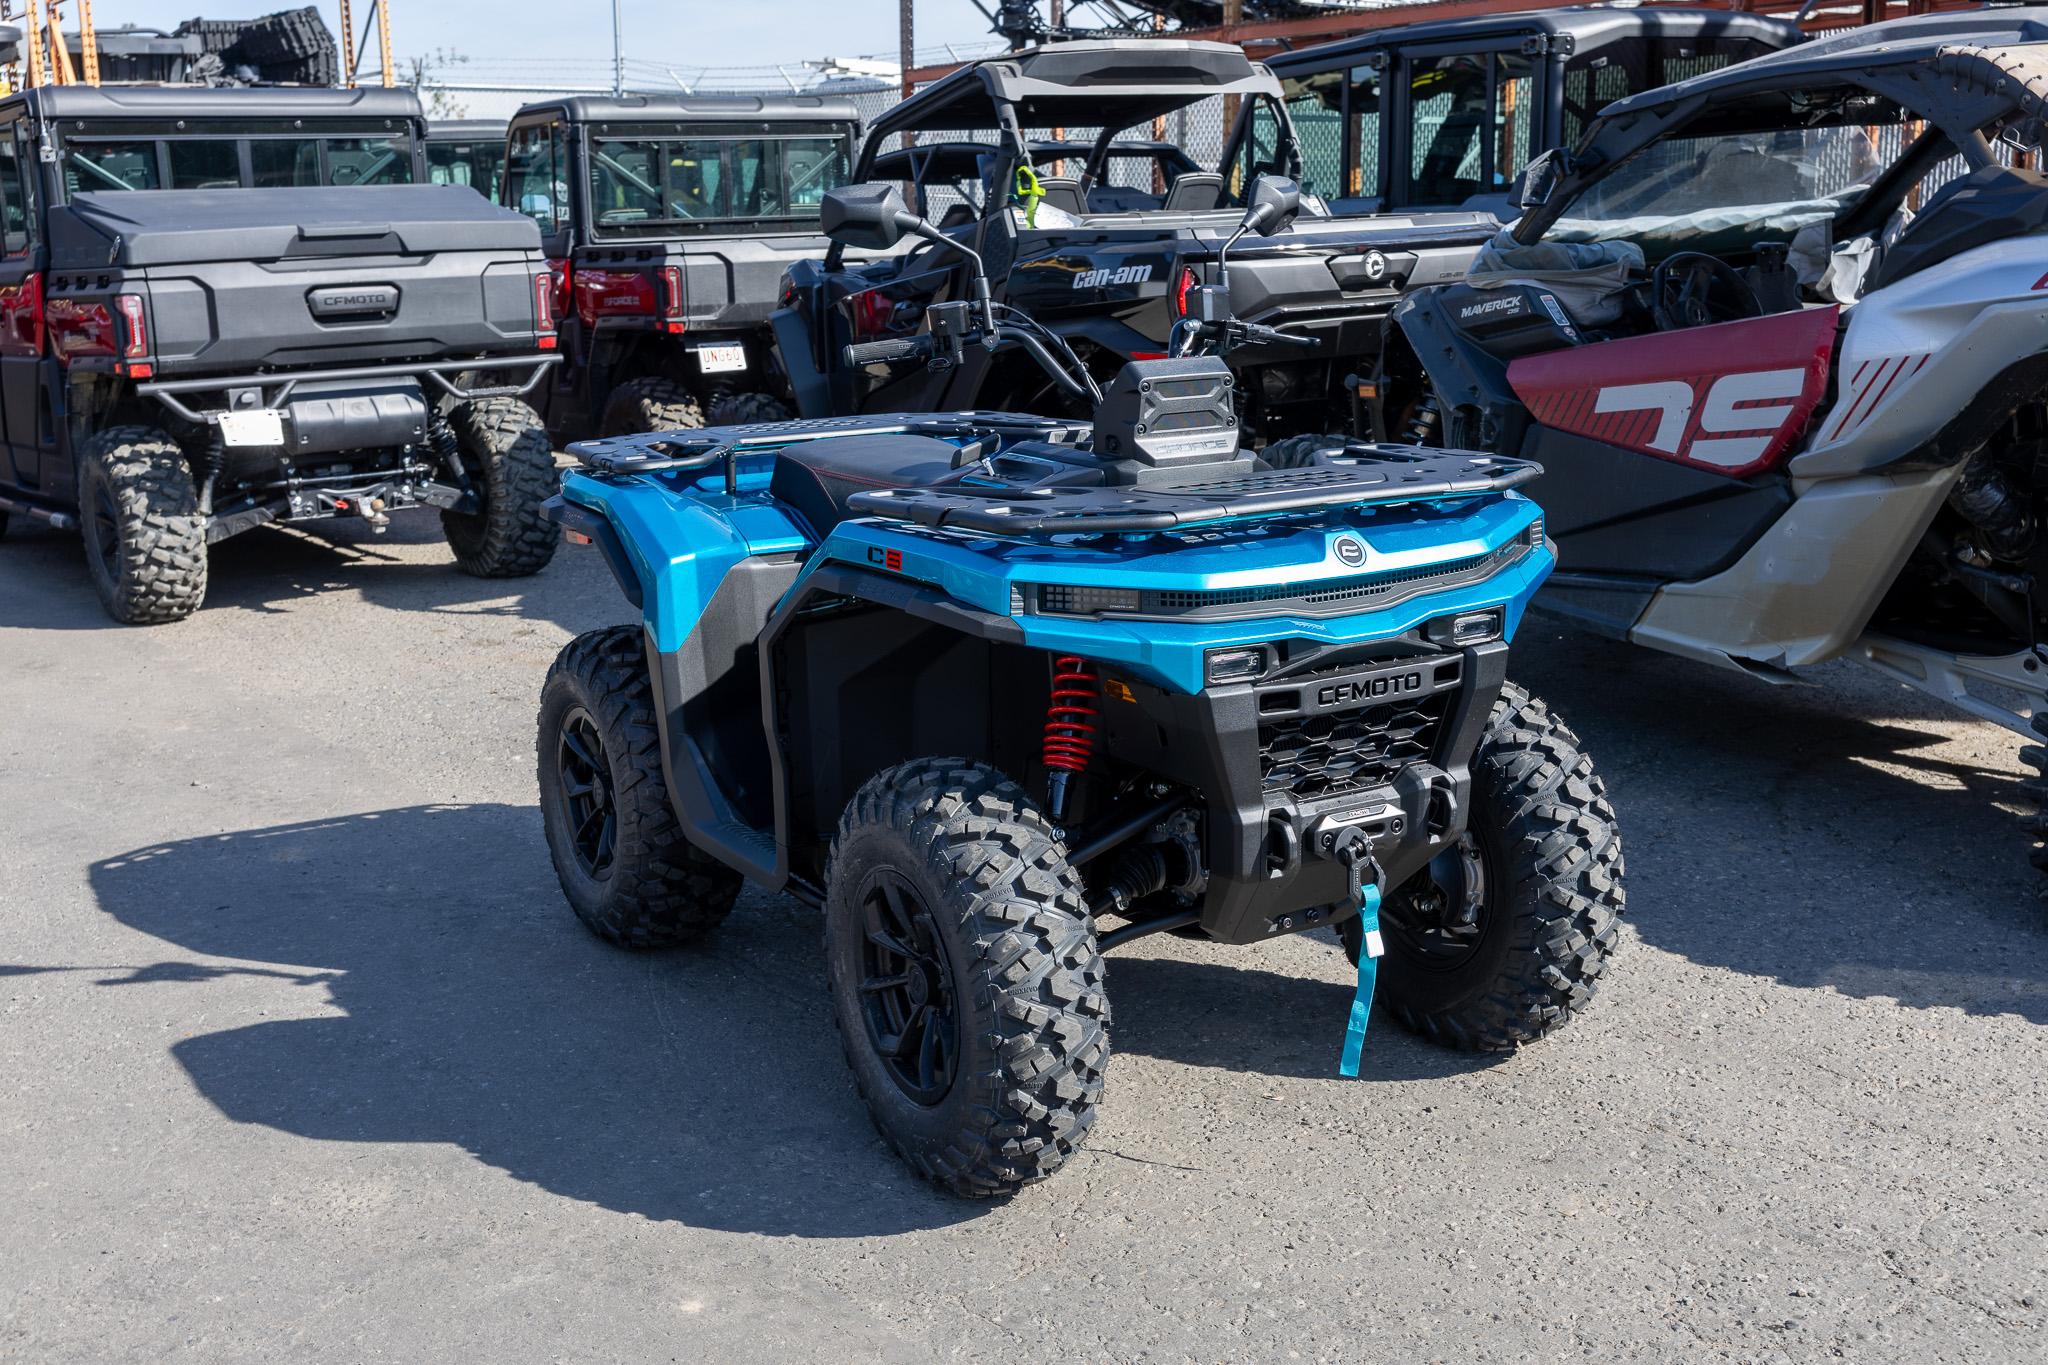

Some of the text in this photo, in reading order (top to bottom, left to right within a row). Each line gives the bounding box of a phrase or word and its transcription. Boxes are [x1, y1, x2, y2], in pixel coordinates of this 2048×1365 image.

[1072, 264, 1152, 289] can-am
[324, 294, 386, 306] CFMOTO
[1460, 295, 1522, 318] MAVERICK
[1317, 672, 1421, 707] CFMOTO
